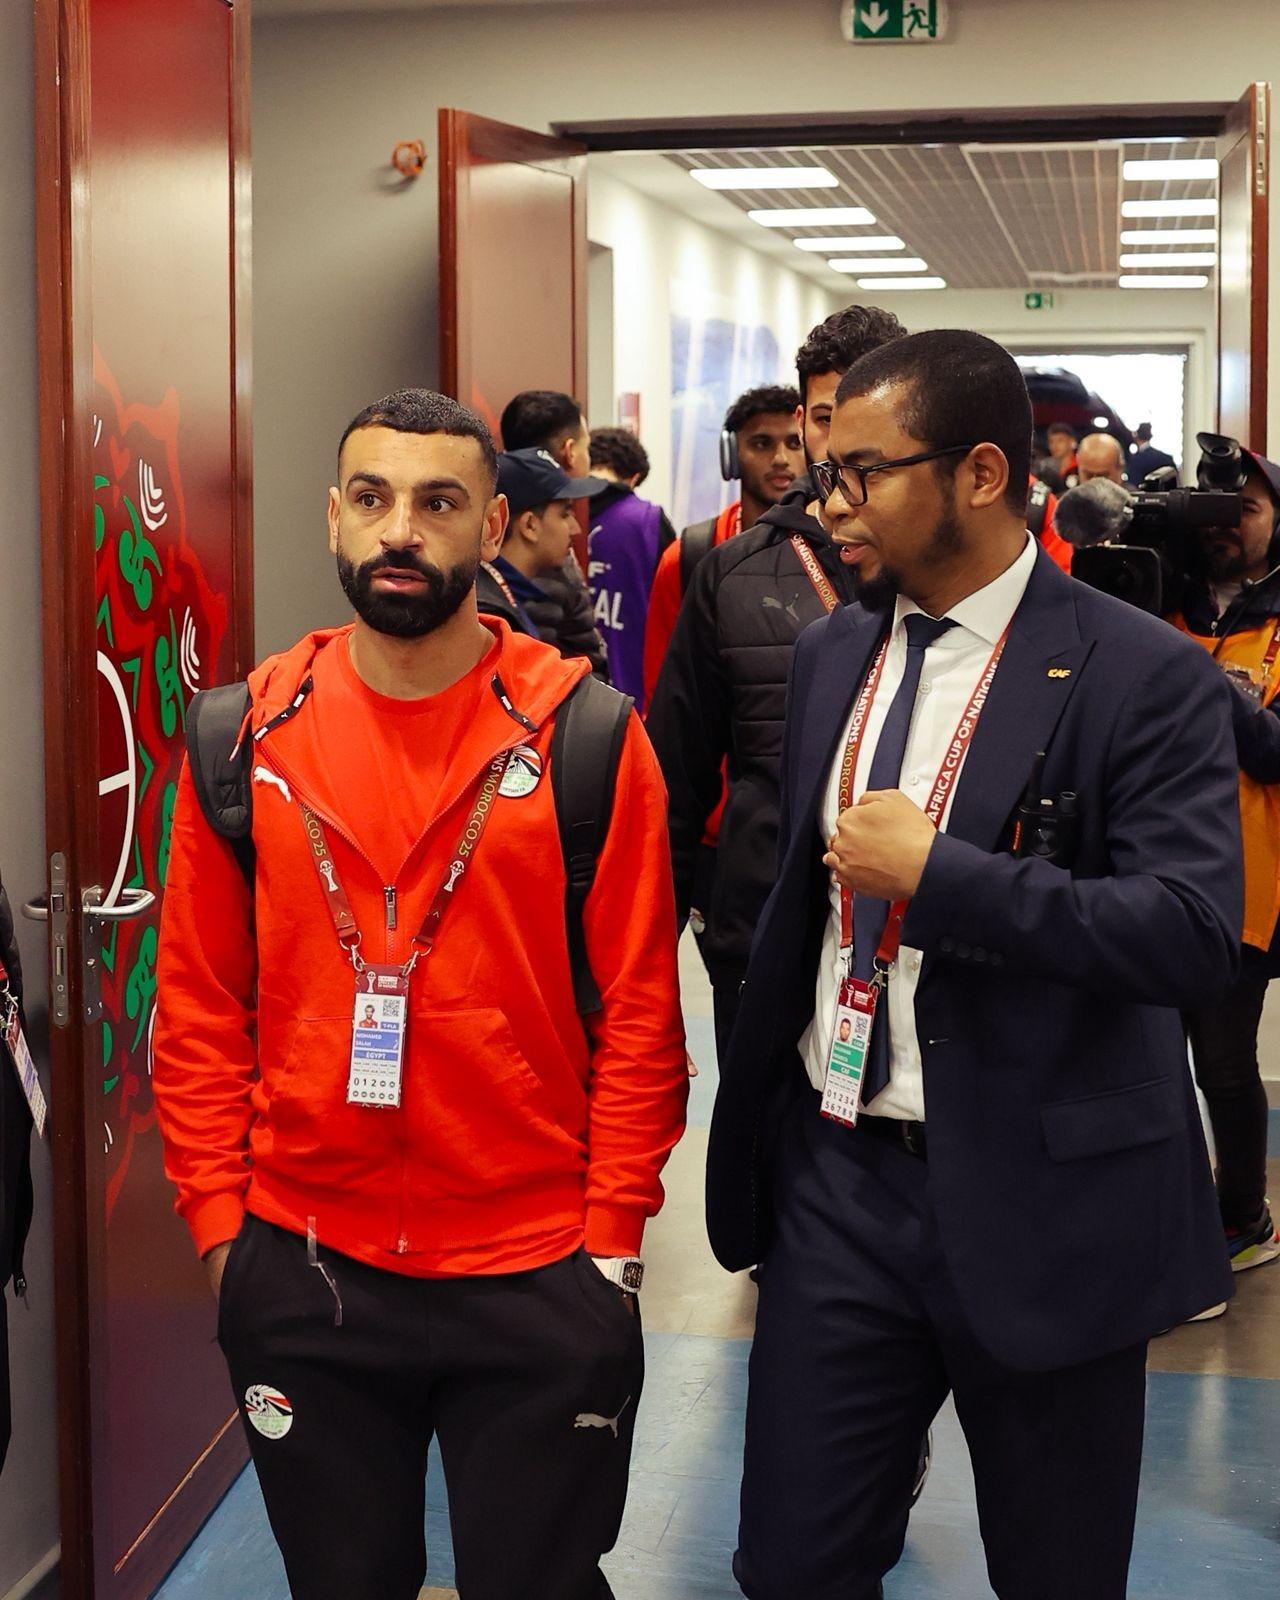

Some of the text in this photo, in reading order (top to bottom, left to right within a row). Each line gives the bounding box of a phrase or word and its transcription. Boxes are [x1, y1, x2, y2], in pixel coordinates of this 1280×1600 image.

[793, 533, 805, 546] OF
[798, 543, 823, 583] NATIONS
[866, 668, 878, 686] OF
[848, 686, 872, 743] NATIONS
[926, 770, 954, 822] AFRICA
[945, 739, 965, 769] CUP
[958, 718, 974, 739] OF
[466, 771, 500, 840] MOROCCO
[312, 840, 327, 857] 25
[458, 840, 473, 858] 25
[365, 1051, 387, 1060] EGYPT
[370, 1079, 377, 1088] 2
